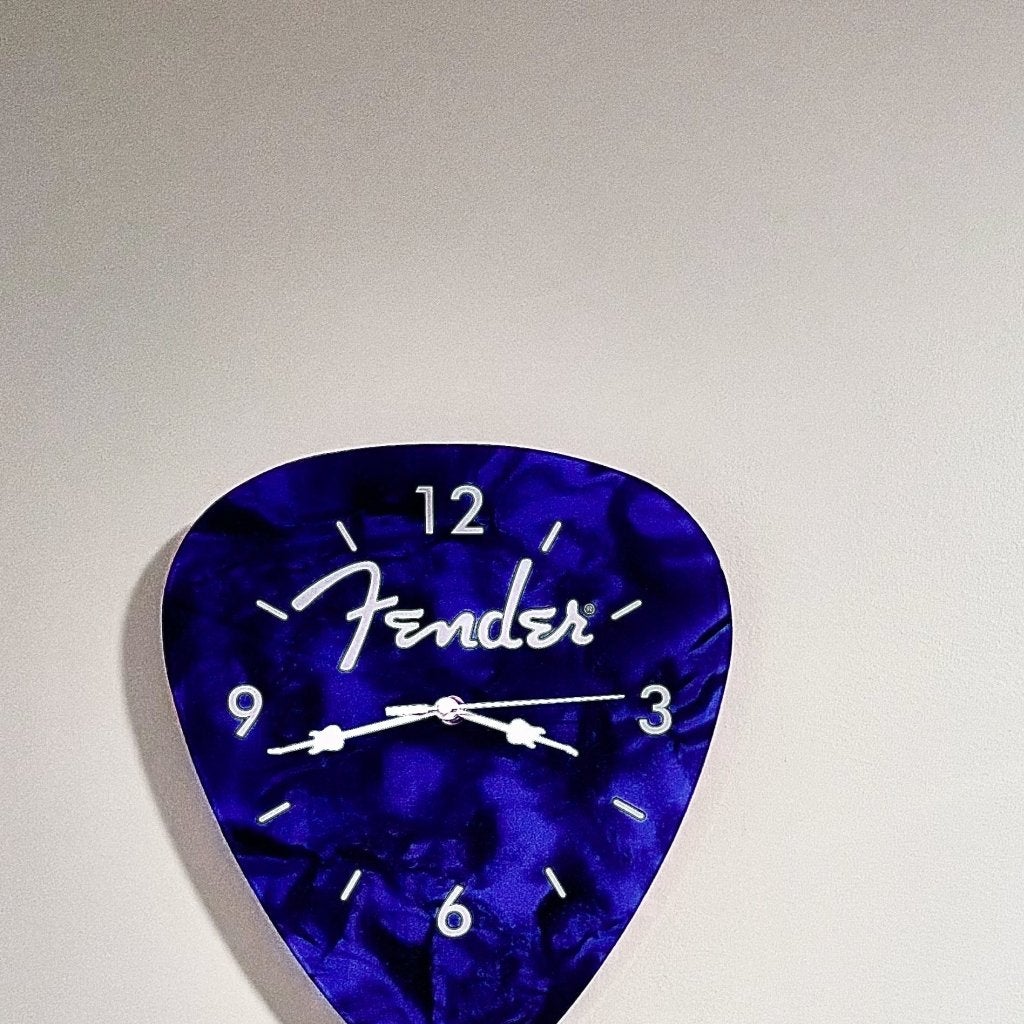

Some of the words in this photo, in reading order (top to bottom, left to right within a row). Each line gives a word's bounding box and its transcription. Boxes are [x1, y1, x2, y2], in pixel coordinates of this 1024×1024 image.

[415, 484, 484, 535] 12
[227, 684, 263, 738] 9
[638, 684, 673, 735] 3
[435, 884, 472, 938] 6
